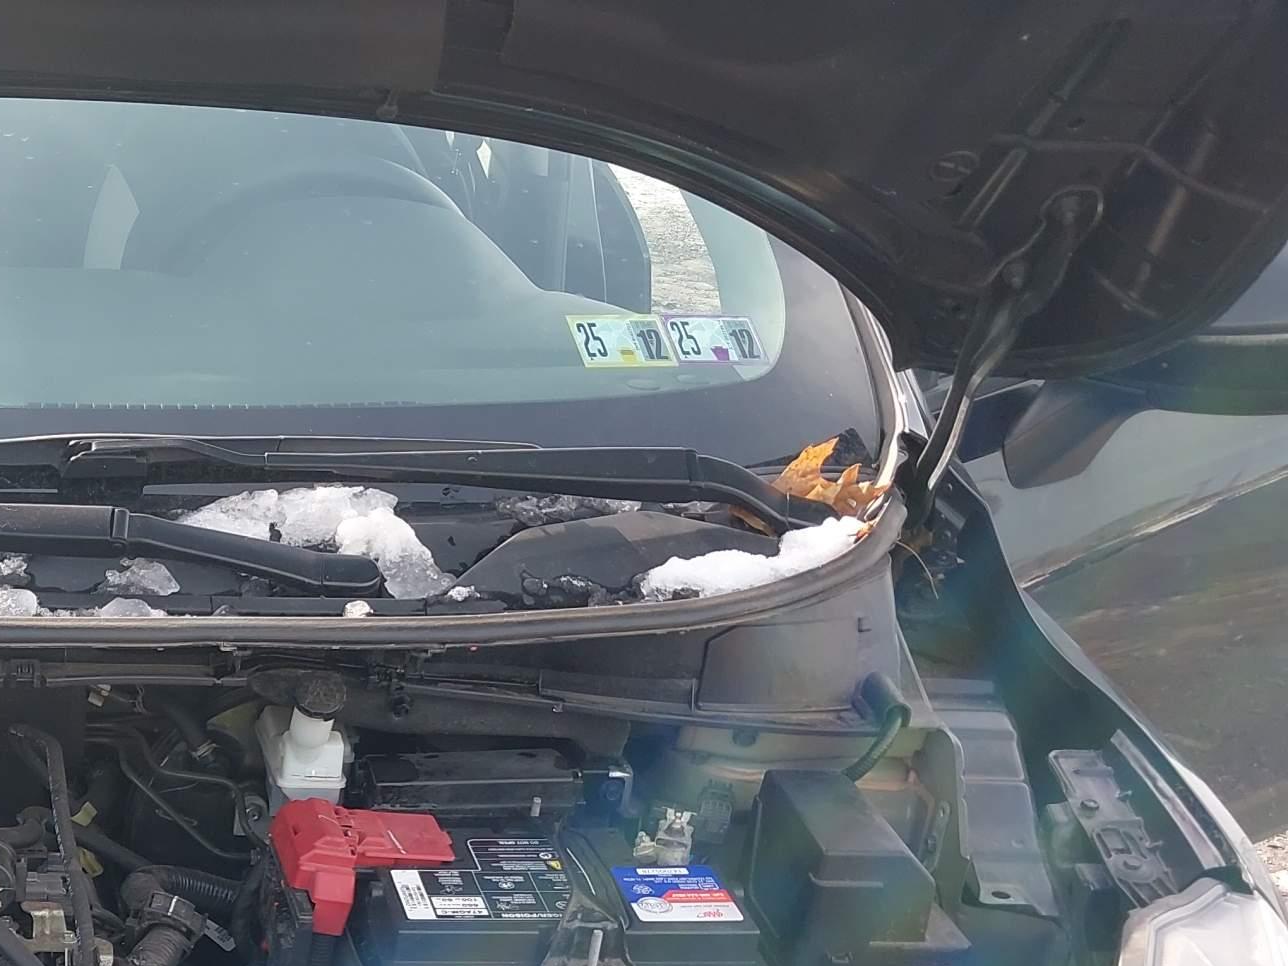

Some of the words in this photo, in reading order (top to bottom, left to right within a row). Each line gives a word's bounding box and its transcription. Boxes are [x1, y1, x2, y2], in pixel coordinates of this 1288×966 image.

[576, 322, 608, 358] 25
[637, 328, 669, 360] 12
[669, 320, 702, 356] 25
[729, 328, 761, 359] 12
